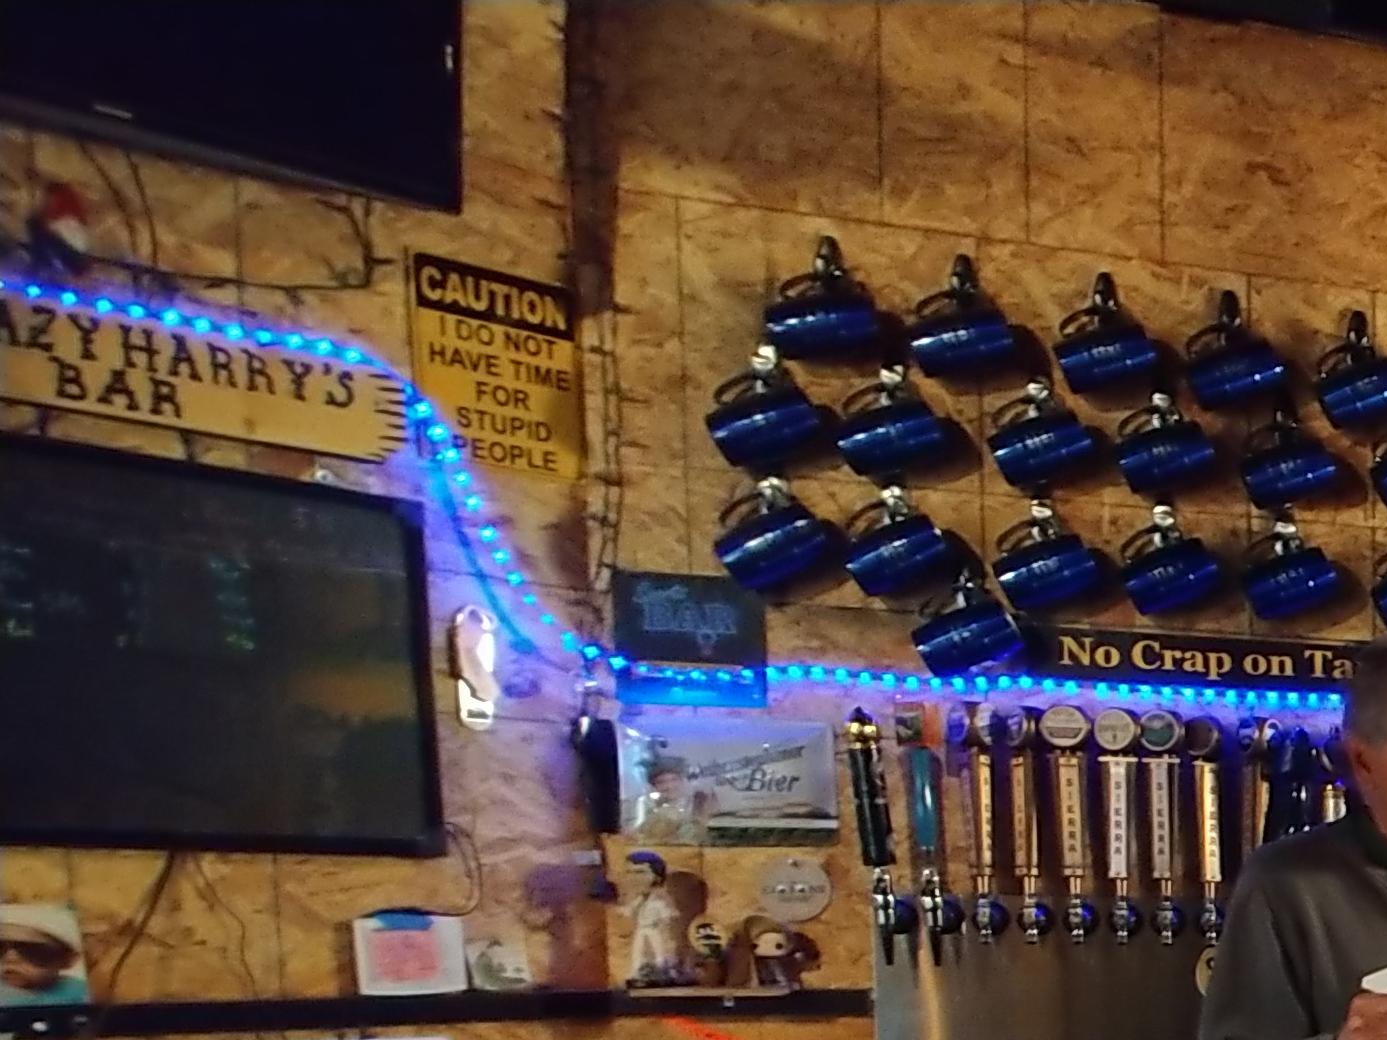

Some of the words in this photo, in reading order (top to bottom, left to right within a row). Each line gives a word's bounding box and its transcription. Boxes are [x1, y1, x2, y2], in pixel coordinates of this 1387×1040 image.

[419, 265, 567, 331] CAUTION
[439, 314, 446, 337] I
[455, 318, 495, 346] DO
[503, 330, 557, 360] NOT
[48, 355, 182, 418] BAR
[119, 324, 355, 408] HARRY'S
[428, 341, 503, 378] HAVE
[508, 358, 572, 392] TIME
[474, 381, 532, 412] FOR
[456, 406, 553, 443] STUPID
[452, 433, 559, 473] PEOPLE
[1058, 635, 1121, 668] No
[1131, 640, 1232, 681] Crap
[1242, 653, 1295, 677] on
[1303, 649, 1354, 680] Ta
[747, 766, 800, 792] Bier
[1113, 780, 1123, 855] SIERRA
[1155, 781, 1166, 856] SIERRA
